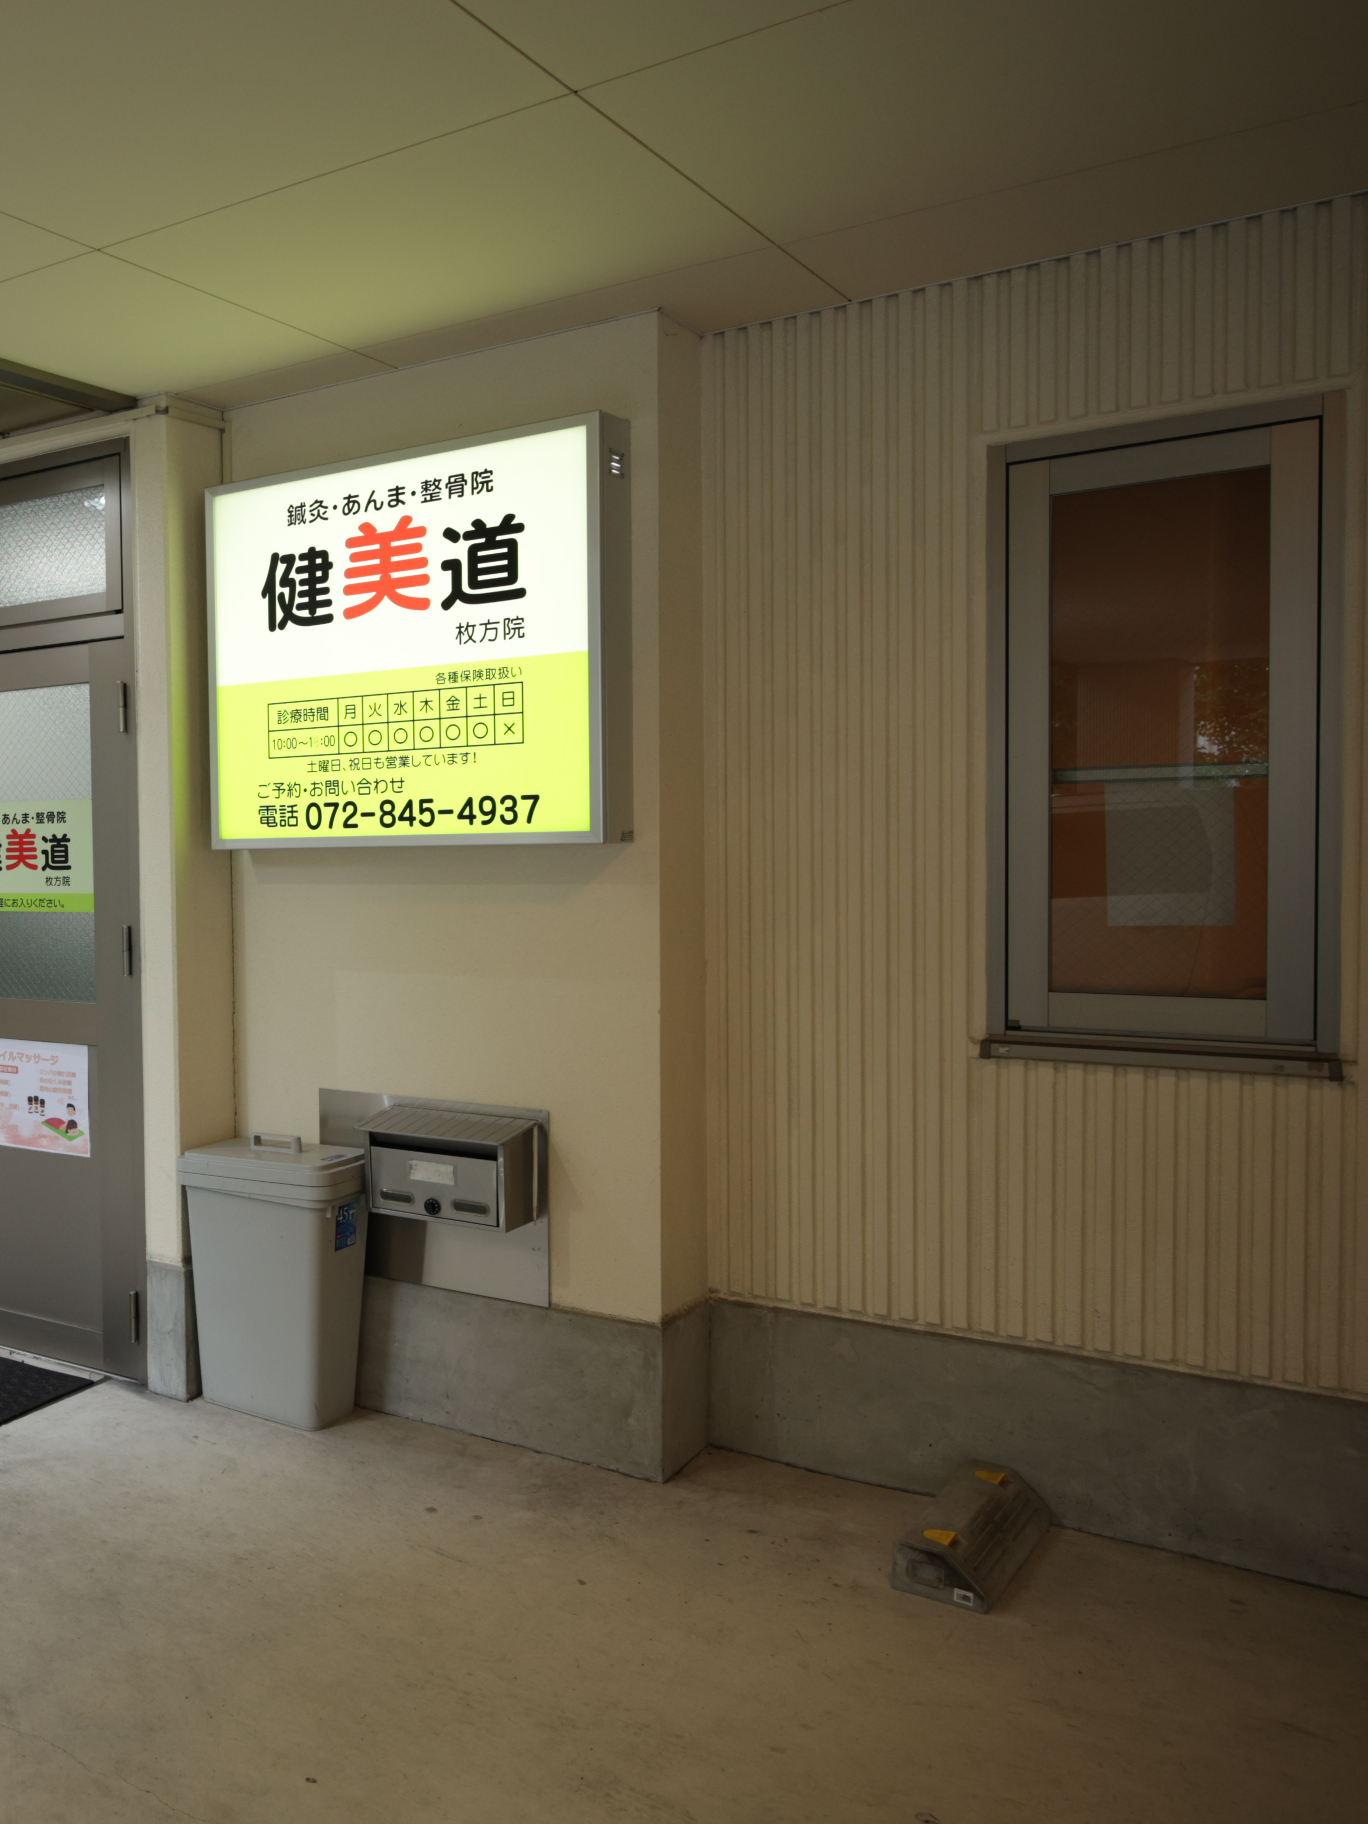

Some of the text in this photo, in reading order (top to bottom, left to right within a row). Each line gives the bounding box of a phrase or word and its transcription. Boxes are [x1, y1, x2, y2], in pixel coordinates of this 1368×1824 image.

[286, 468, 494, 527] 鍼灸・あんま・整骨院
[260, 513, 527, 633] 健美道
[454, 616, 526, 646] 枚方院
[434, 666, 523, 686] 各種保険取扱い
[276, 691, 515, 725] 診療時間 月 火 水 木 金 土 日
[256, 776, 406, 800] ご予約・お問い合わせ
[257, 794, 541, 831] 電話 072-845-4937
[44, 875, 71, 888] 枚方院
[337, 1206, 349, 1224] 45
